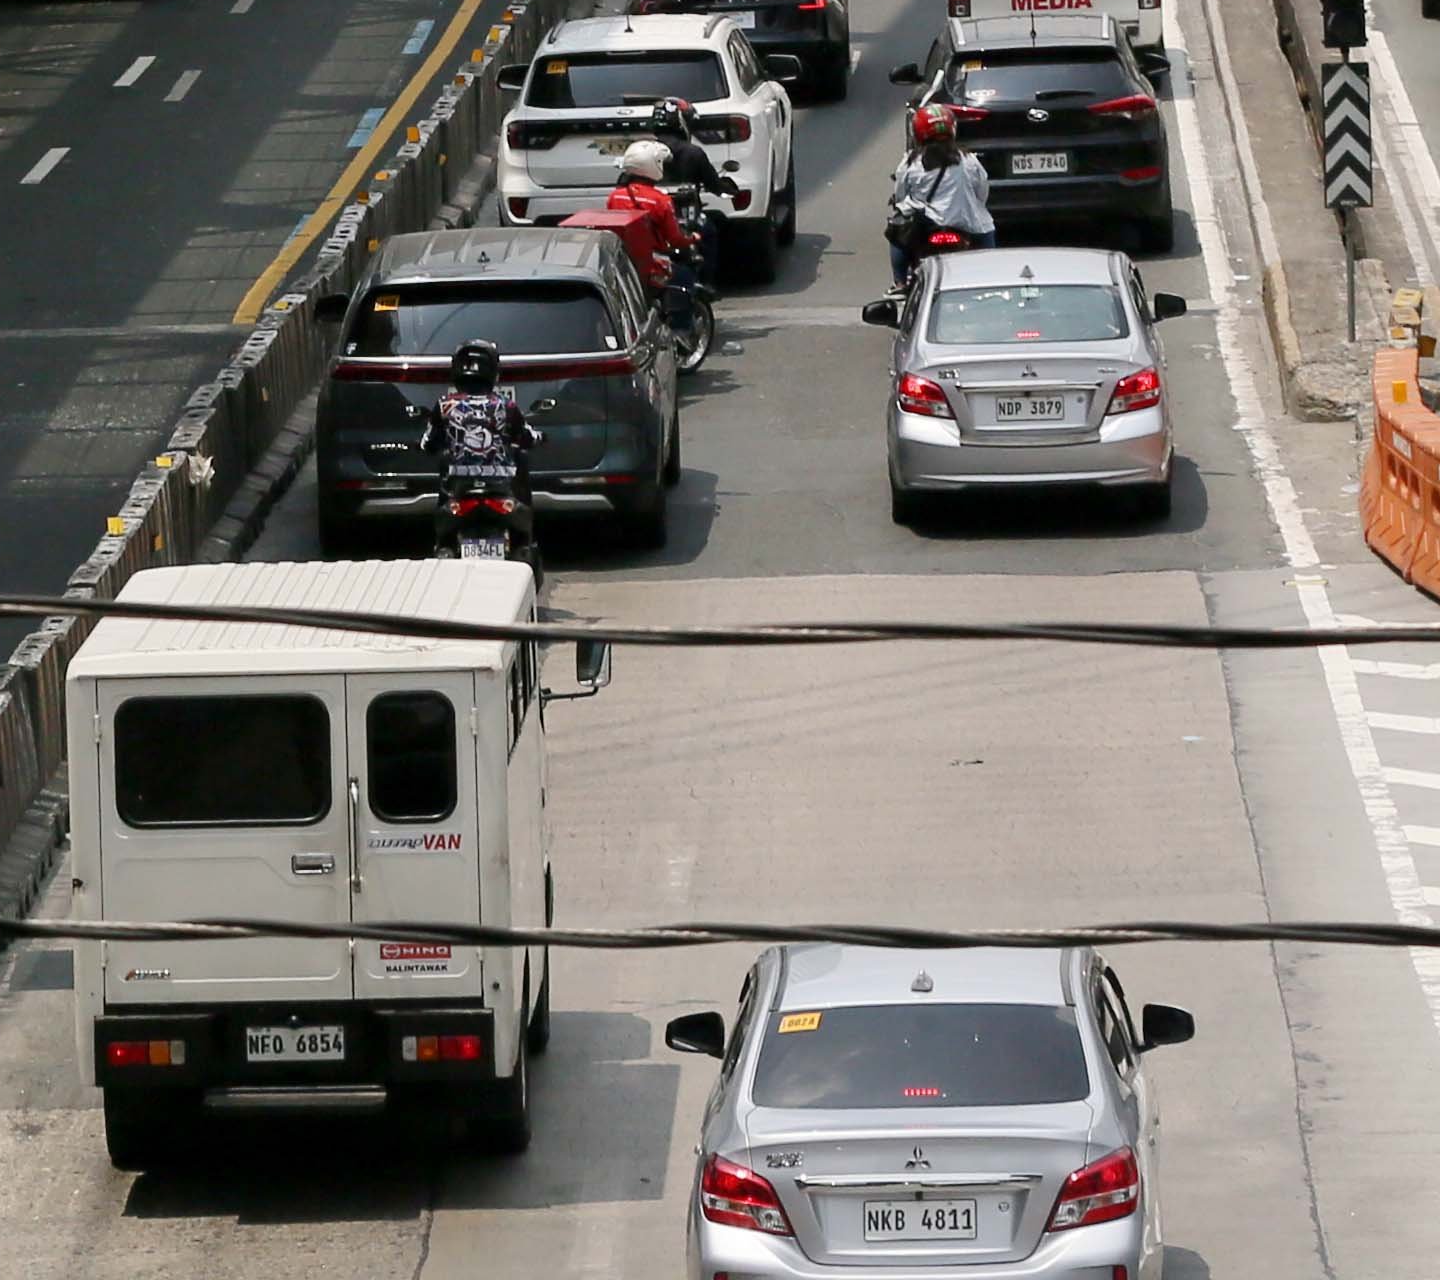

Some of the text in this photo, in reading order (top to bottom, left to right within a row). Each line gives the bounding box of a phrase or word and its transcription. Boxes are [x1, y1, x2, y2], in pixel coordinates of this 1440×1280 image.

[1013, 155, 1033, 170] NDS
[999, 397, 1062, 417] NDP 3879
[400, 945, 449, 957] HINO
[386, 964, 448, 974] BALINTAWAK
[248, 1033, 343, 1055] NFO 6854
[868, 1208, 973, 1232] NKB 4811
